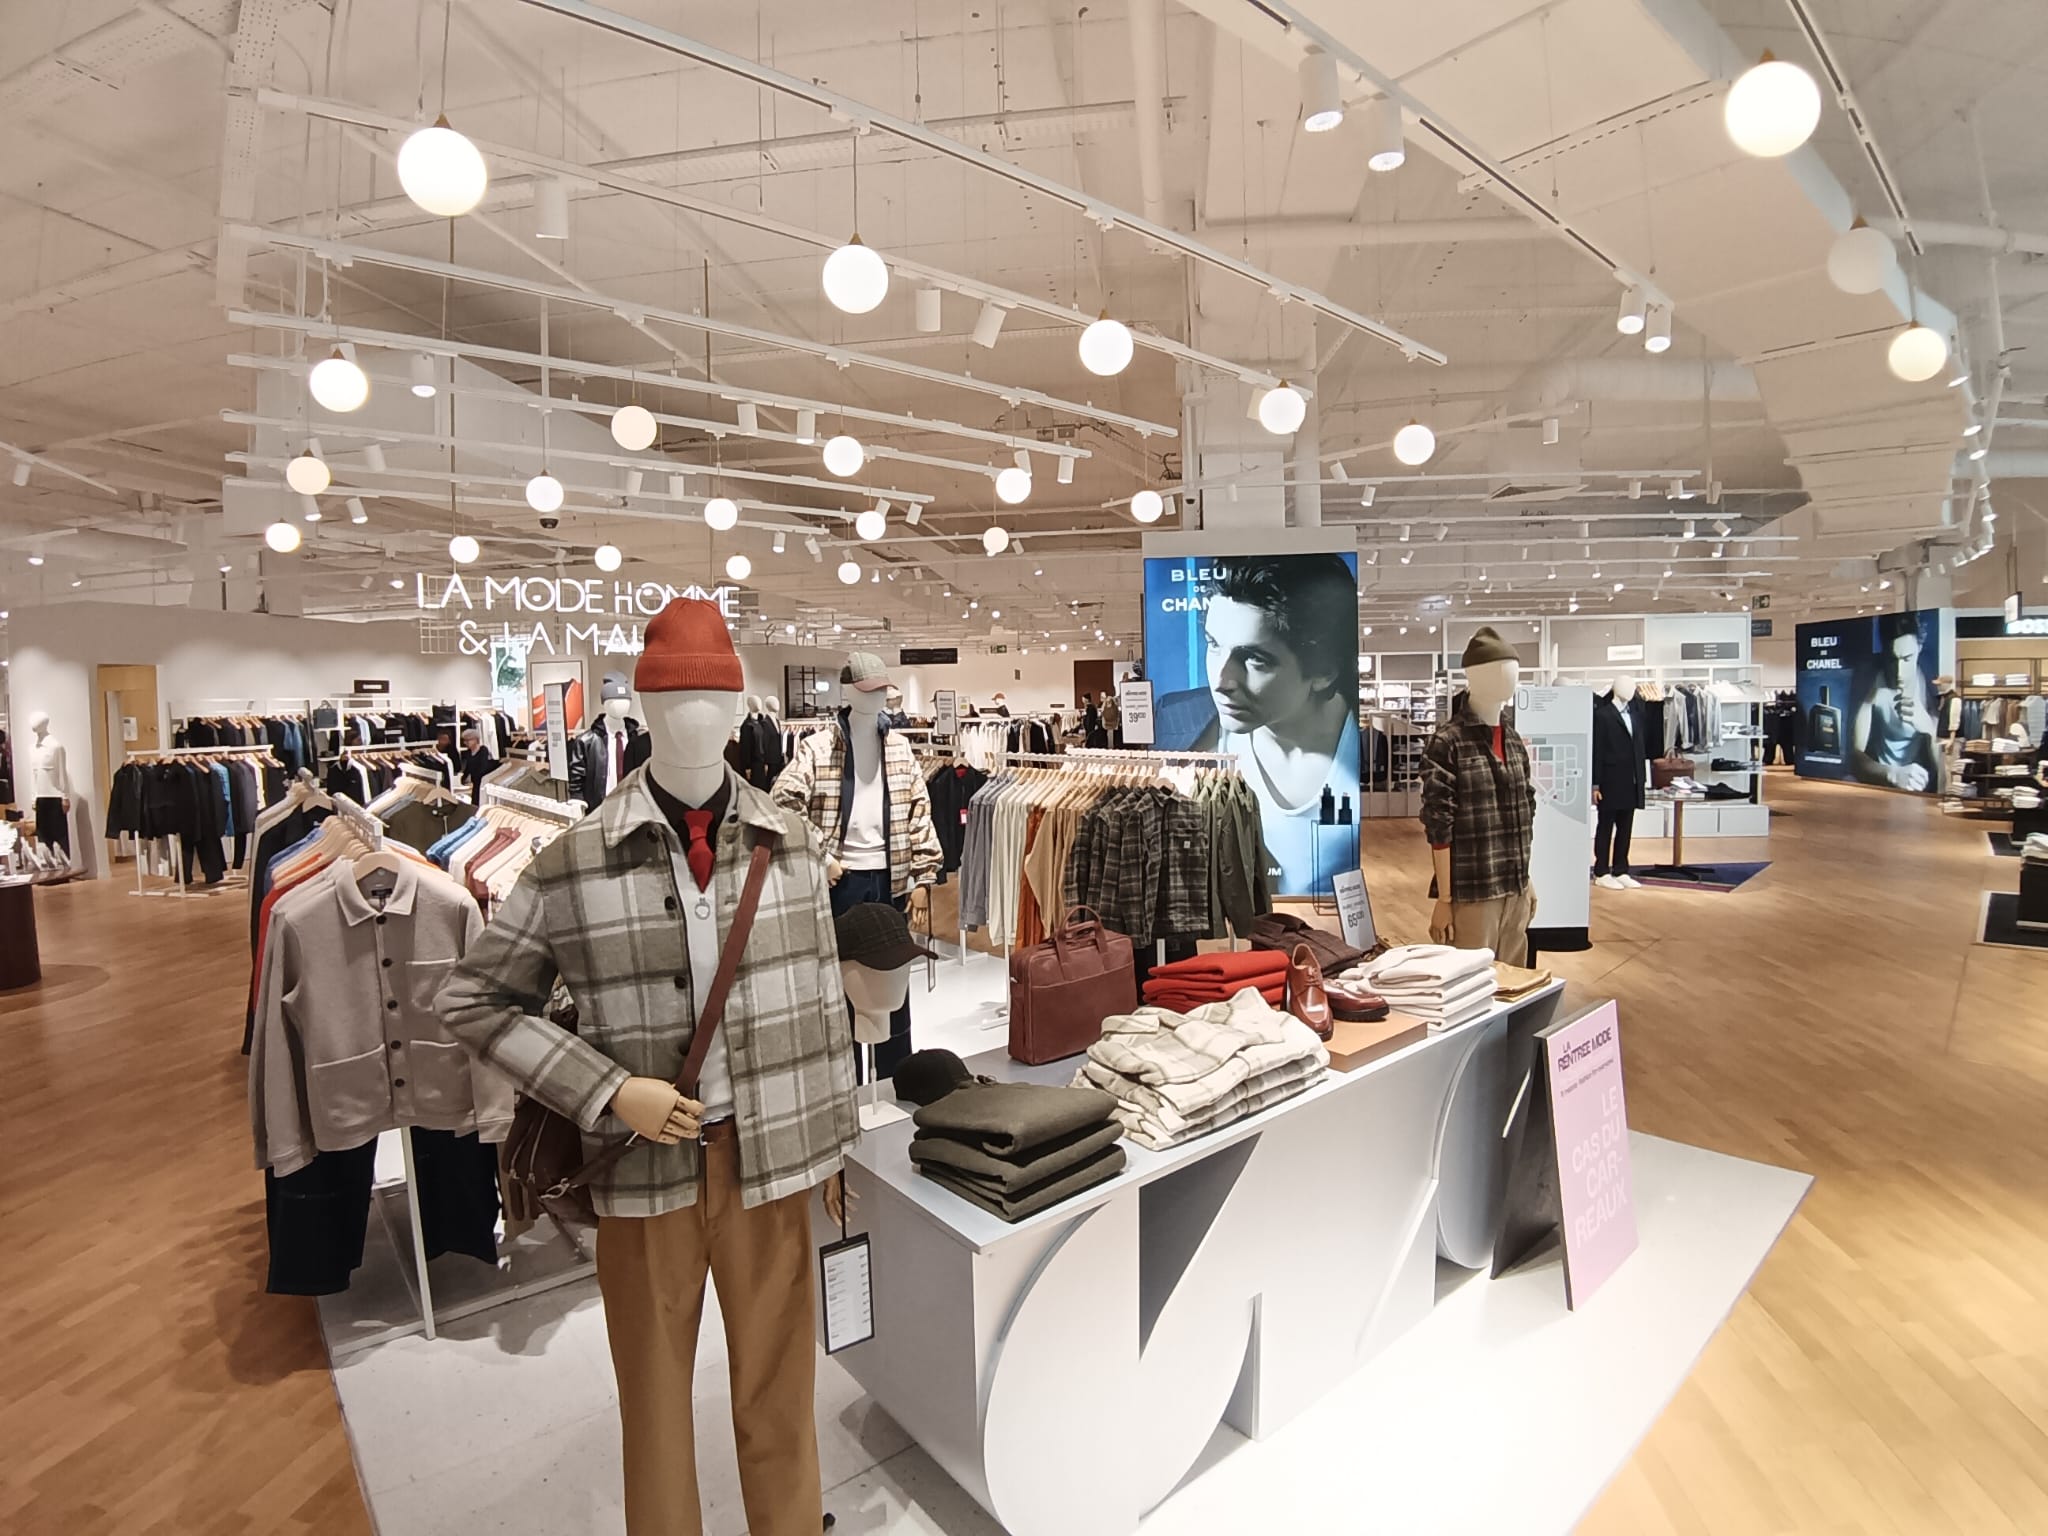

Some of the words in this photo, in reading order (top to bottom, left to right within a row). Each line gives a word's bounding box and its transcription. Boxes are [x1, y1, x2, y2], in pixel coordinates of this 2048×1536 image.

[1171, 567, 1227, 582] BLEU
[417, 572, 473, 610] LA
[485, 575, 604, 614] MODE
[614, 580, 740, 618] HOMME
[458, 620, 489, 655] &
[1810, 636, 1837, 648] BLEU
[1806, 658, 1842, 670] CHANEL
[1591, 1027, 1612, 1051] MODE
[1601, 1085, 1618, 1117] LE
[1572, 1132, 1600, 1173] CAS
[1601, 1114, 1620, 1149] DU
[1575, 1174, 1628, 1249] REAUX
